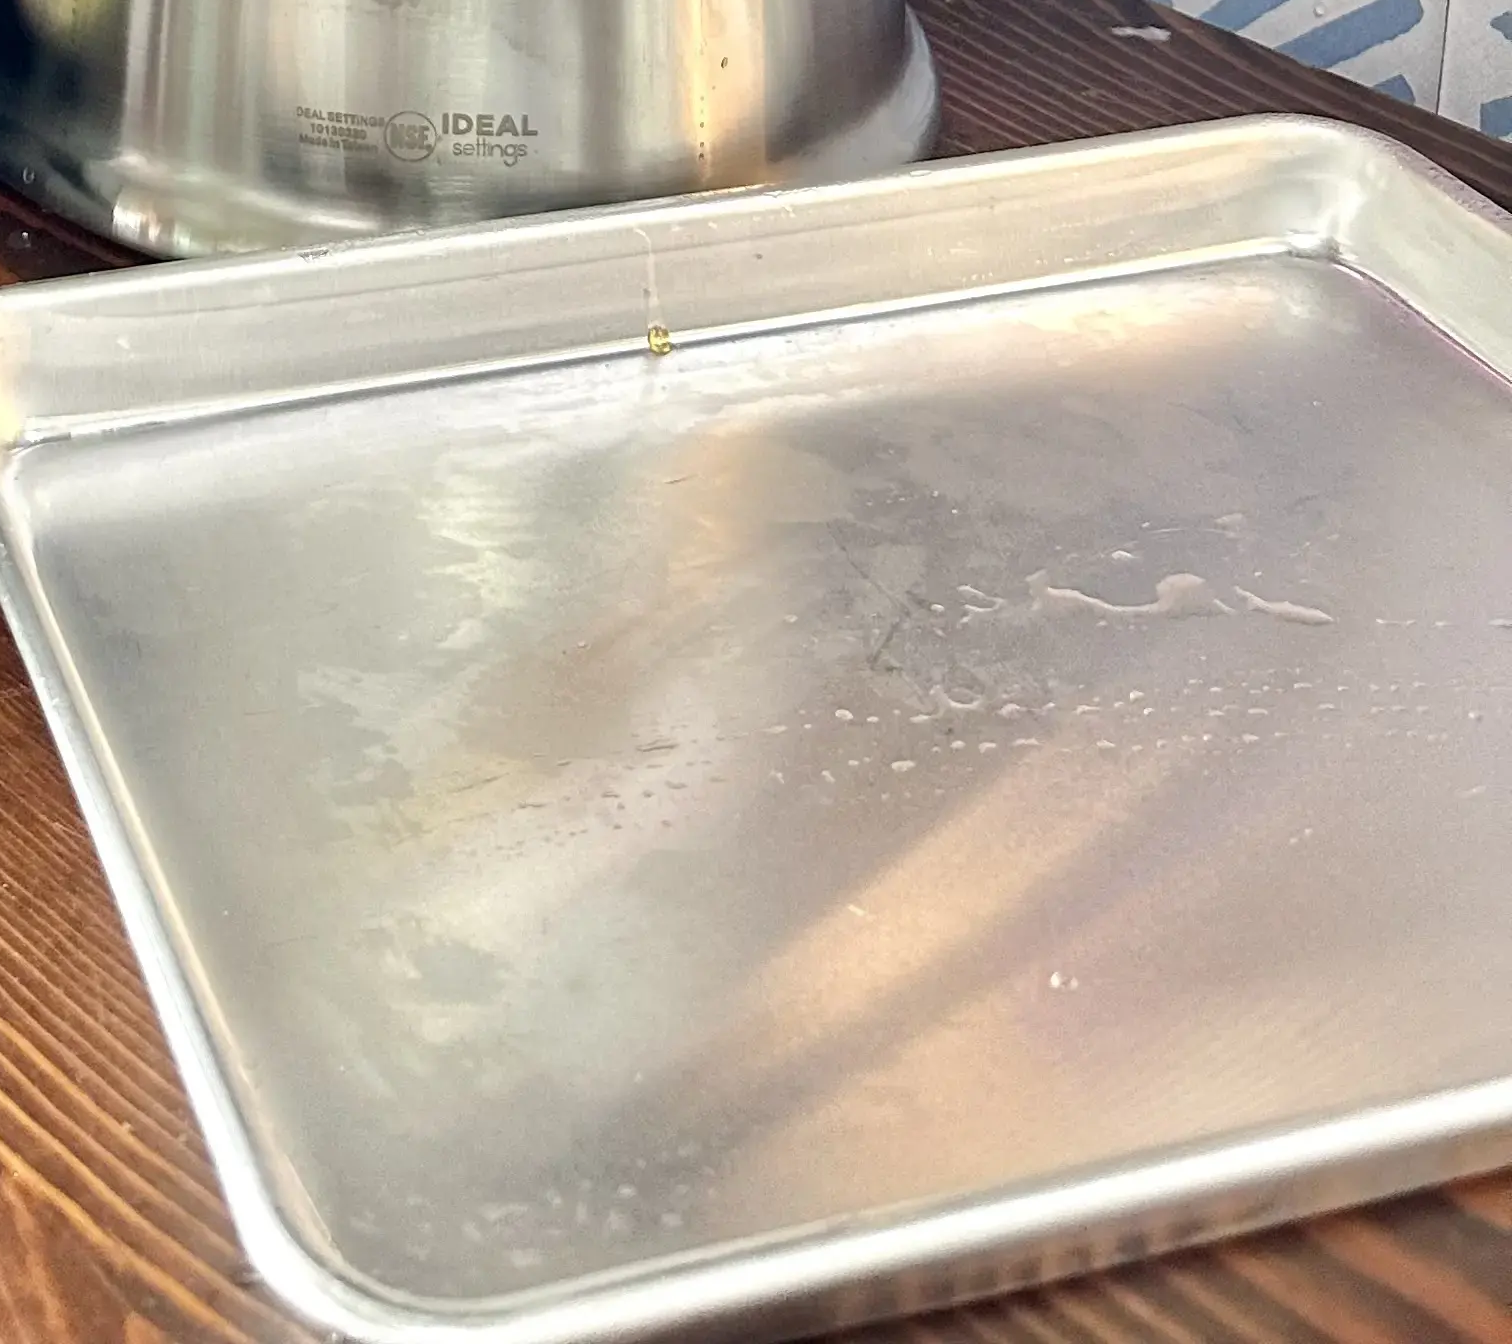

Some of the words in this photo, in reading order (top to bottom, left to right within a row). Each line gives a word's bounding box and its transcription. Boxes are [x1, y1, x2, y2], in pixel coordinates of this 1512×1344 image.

[327, 111, 385, 127] SETTINGS
[441, 112, 538, 136] IDEAL
[452, 138, 528, 167] settings
